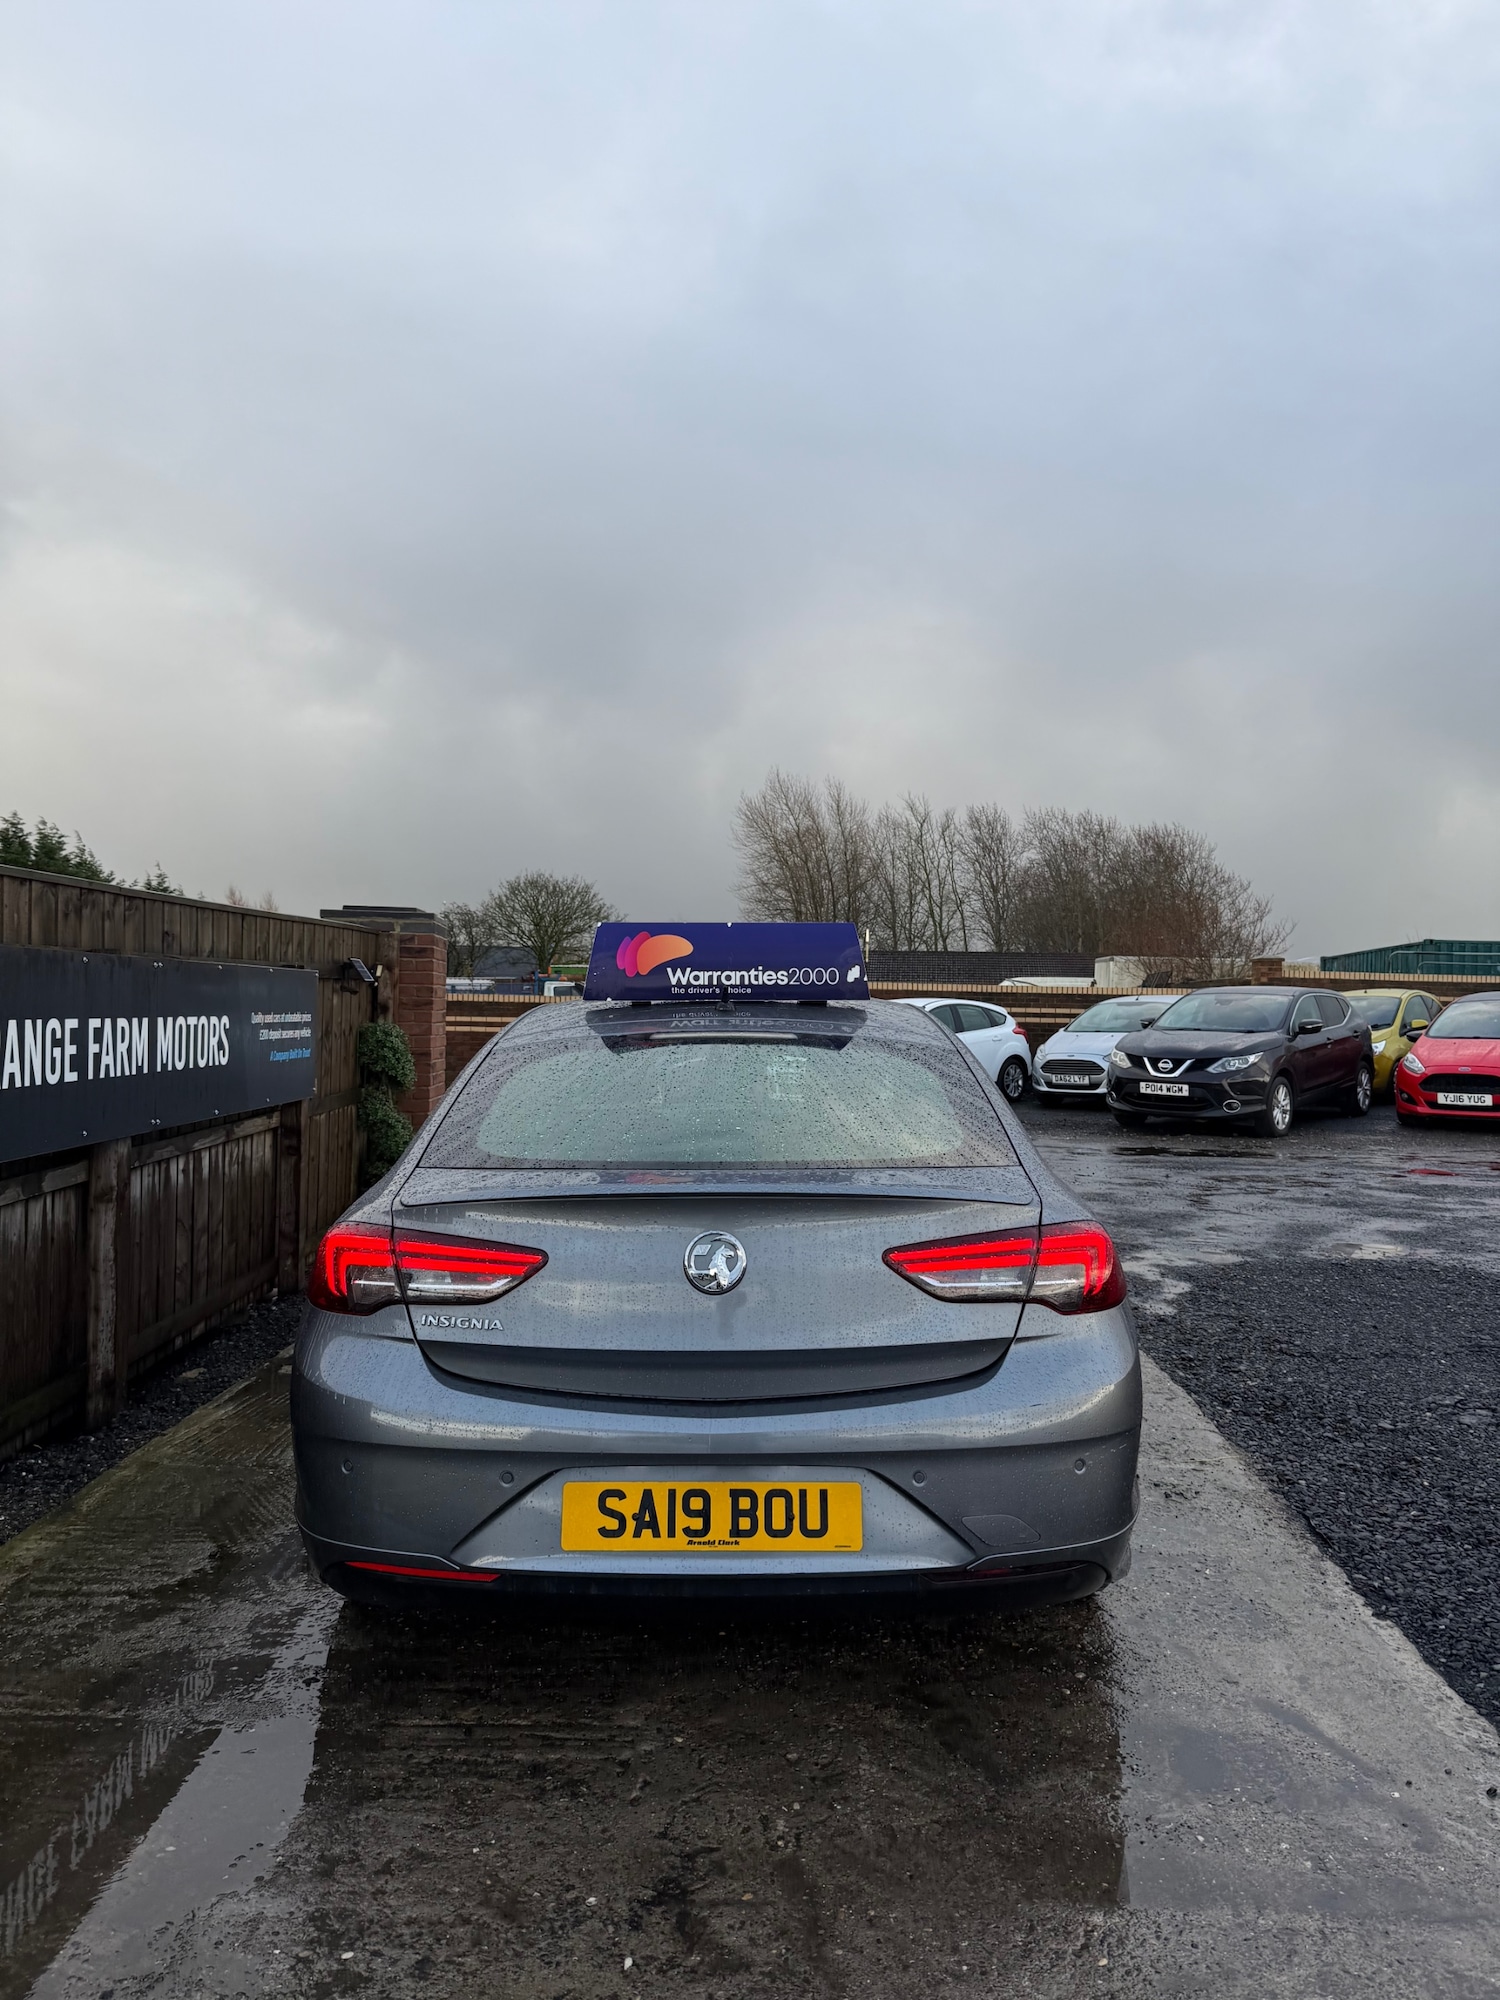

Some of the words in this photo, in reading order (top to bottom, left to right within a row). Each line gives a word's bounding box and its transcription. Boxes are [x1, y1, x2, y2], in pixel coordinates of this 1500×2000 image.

[666, 965, 840, 986] Warranties2000
[671, 986, 686, 994] the
[688, 986, 721, 994] driver's
[723, 986, 752, 994] hoice
[0, 1017, 79, 1090] ANGE
[87, 1017, 149, 1080] FARM
[156, 1014, 230, 1073] MOTORS
[1144, 1083, 1163, 1093] PO14
[1165, 1084, 1184, 1094] WGM
[1443, 1094, 1465, 1103] YJ16
[1466, 1095, 1486, 1104] YUG
[421, 1314, 504, 1331] INSIGNIA
[597, 1488, 711, 1539] SA19
[729, 1488, 829, 1539] BOU
